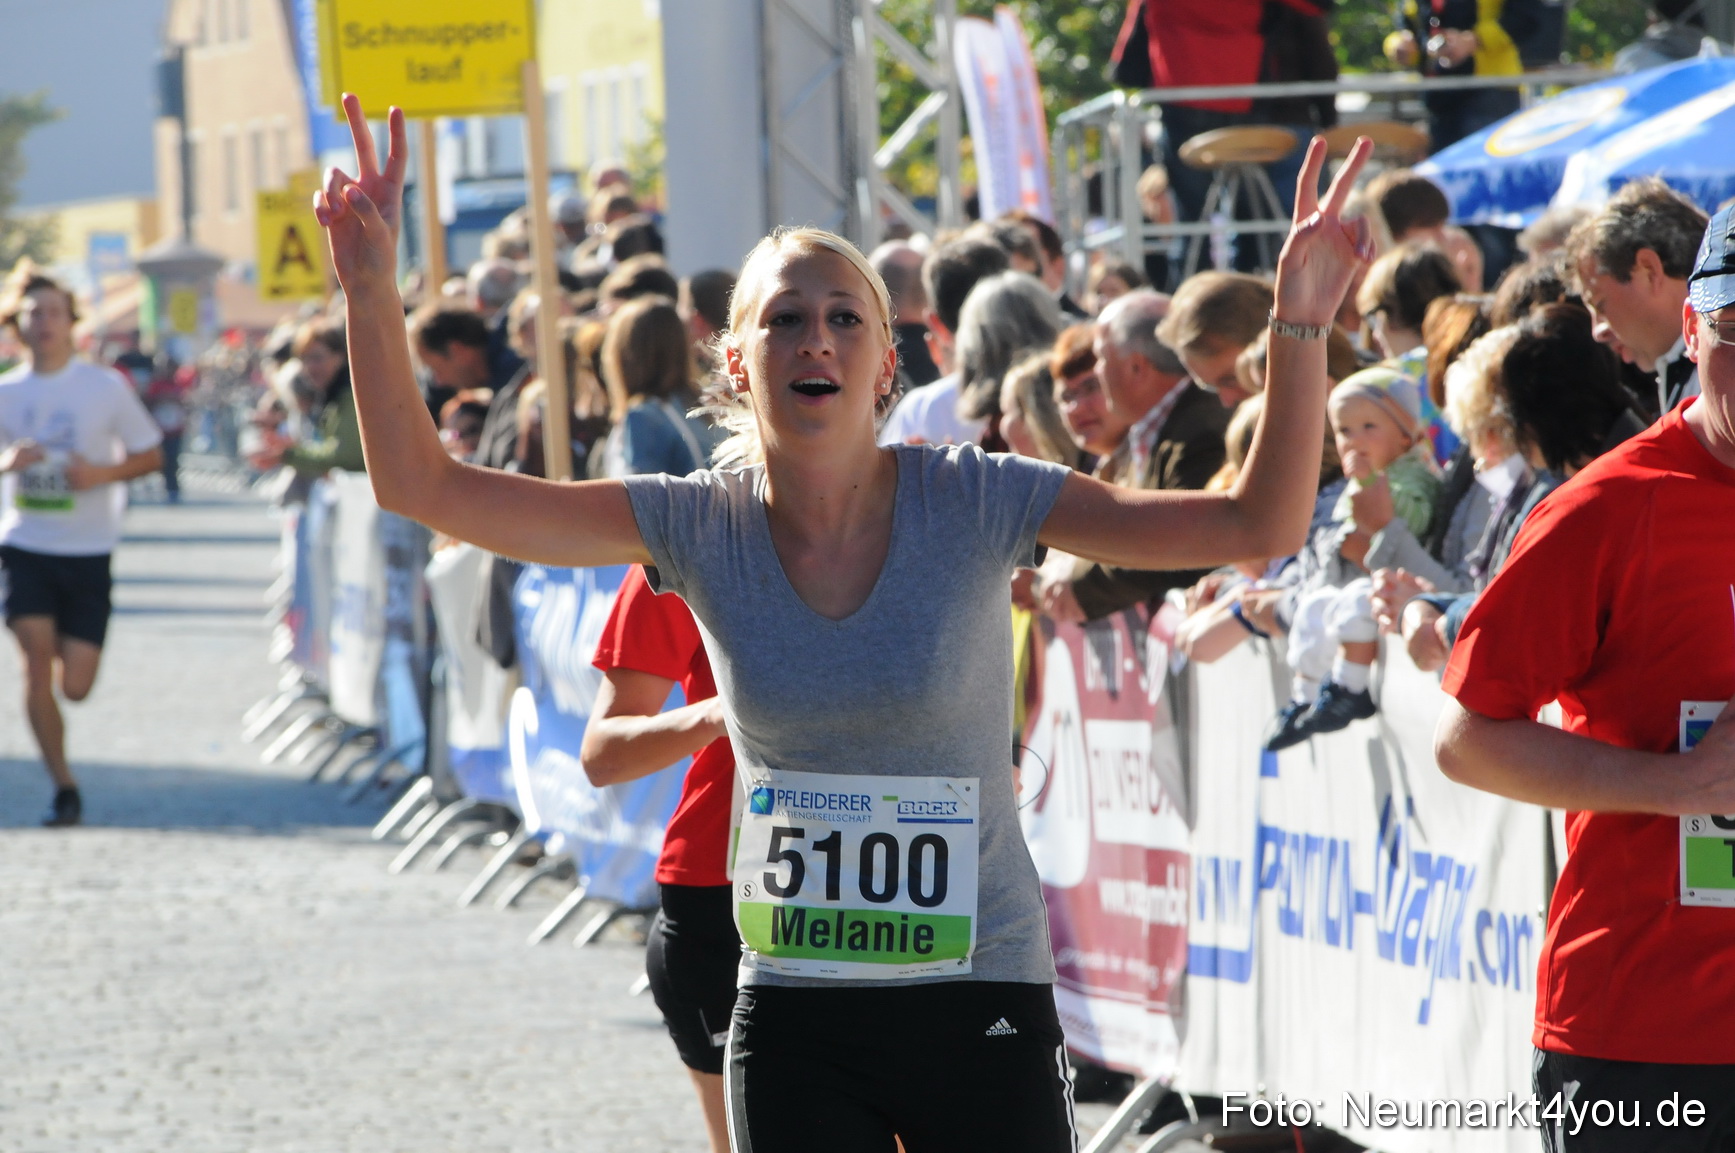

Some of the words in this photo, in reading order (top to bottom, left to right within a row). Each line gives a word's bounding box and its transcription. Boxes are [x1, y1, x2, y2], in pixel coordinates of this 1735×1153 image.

[344, 20, 520, 48] Schnupper-
[405, 56, 462, 82] lauf
[275, 225, 314, 274] A
[776, 789, 872, 812] PFLEIDERER
[898, 801, 957, 815] BOCK
[776, 810, 872, 823] AKTIENGESELLSCHAFT
[763, 826, 949, 908] 5100
[771, 906, 935, 955] Melanie
[985, 1027, 1018, 1036] adidas
